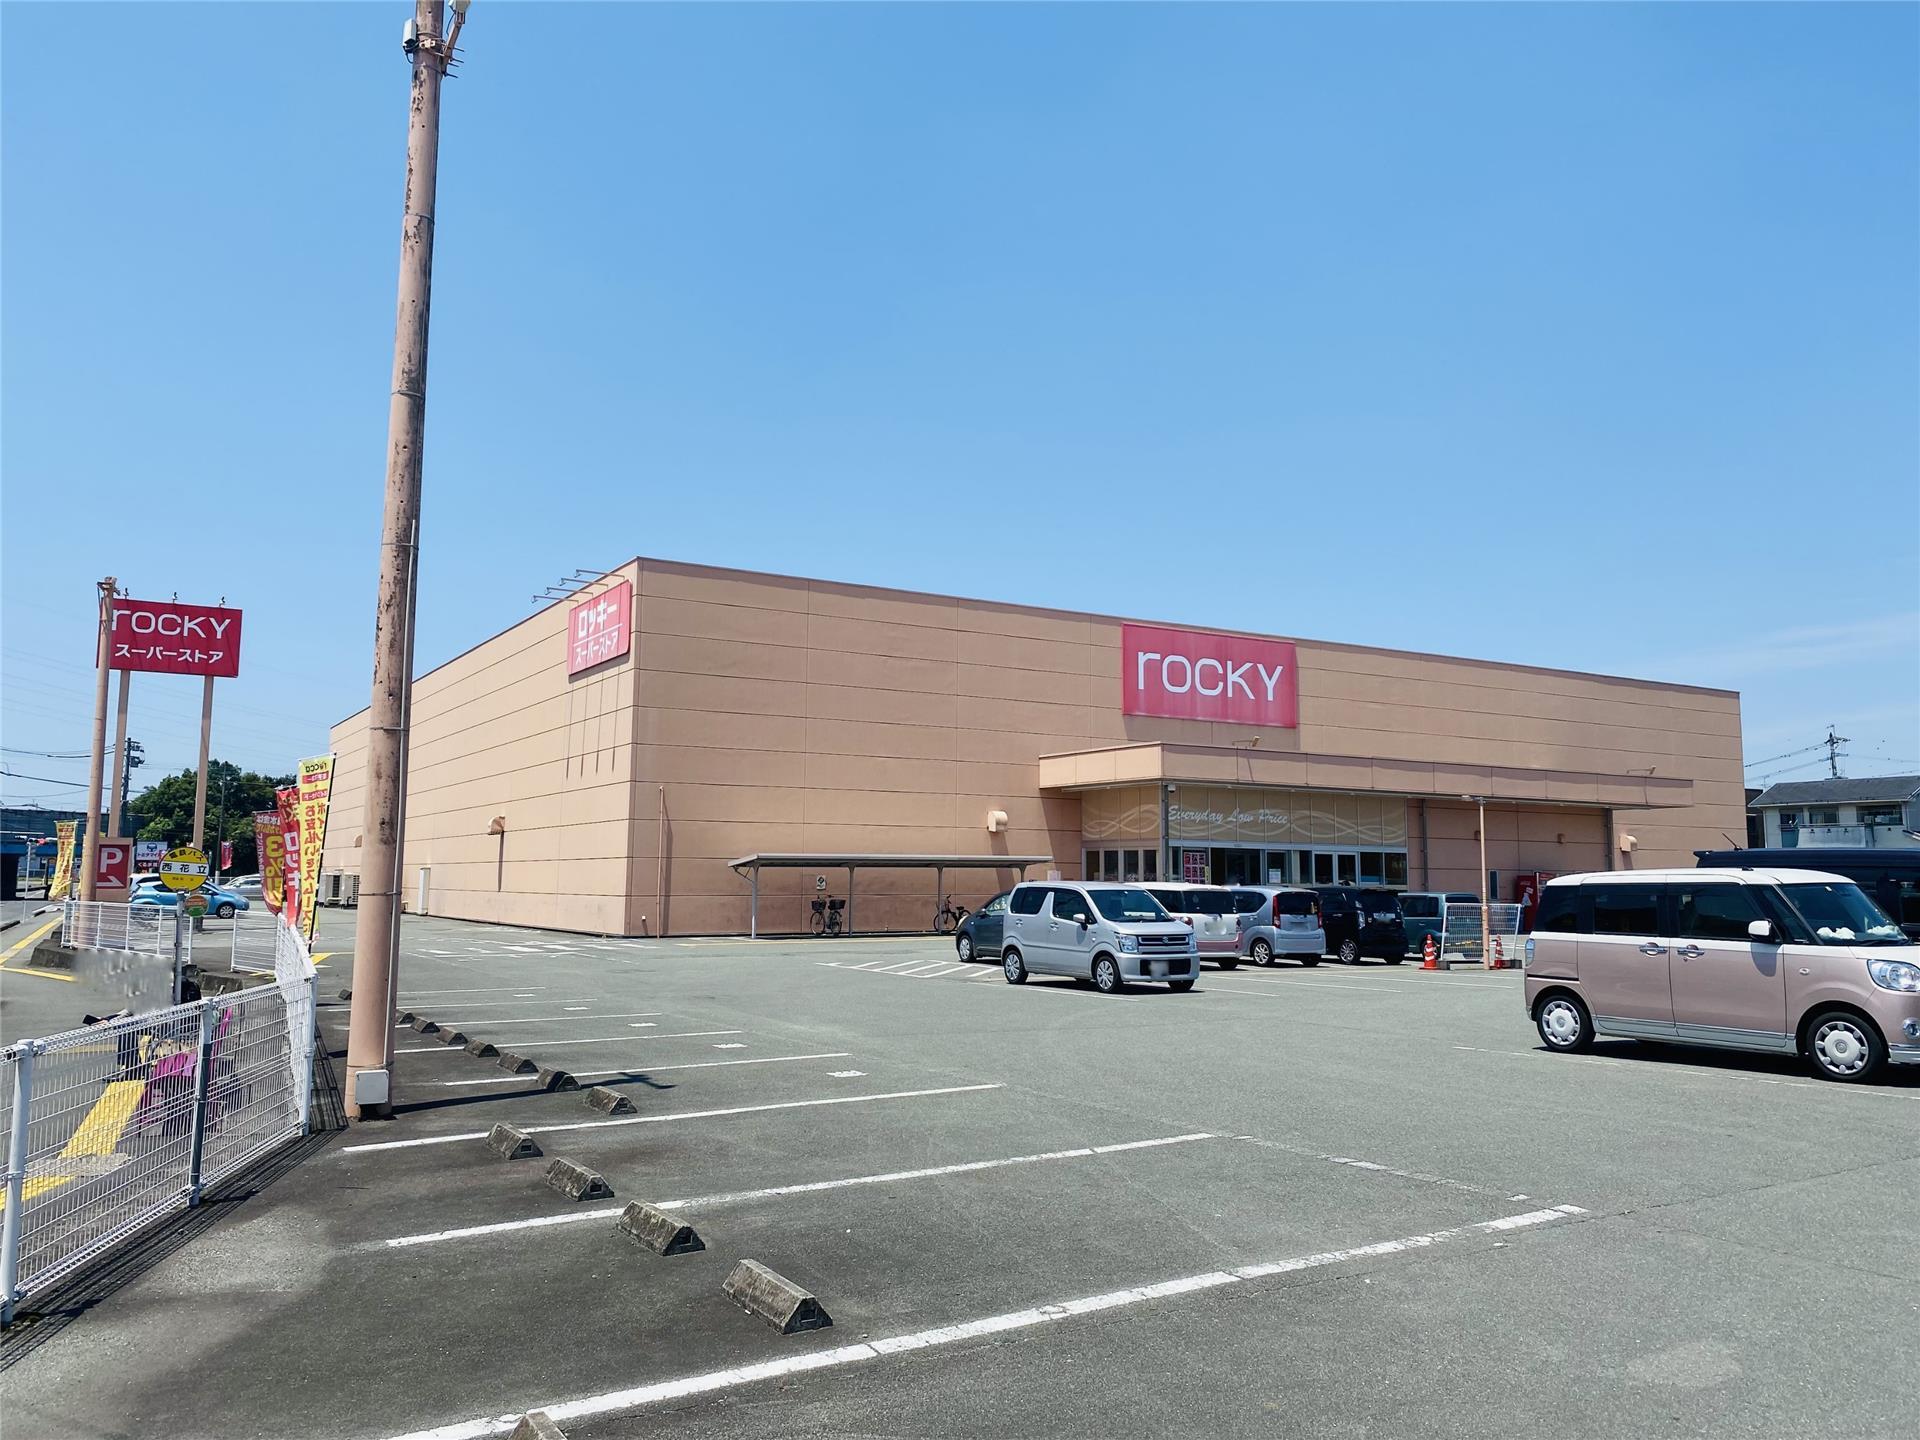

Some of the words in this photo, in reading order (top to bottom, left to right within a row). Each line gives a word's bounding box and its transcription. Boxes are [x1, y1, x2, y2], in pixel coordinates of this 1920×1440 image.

[578, 600, 617, 639] ロッキー
[115, 644, 223, 663] スーパーストア
[576, 630, 619, 665] スーパーストア
[1168, 805, 1224, 824] Everyday
[1226, 808, 1253, 822] Low
[1258, 808, 1288, 824] Price
[100, 847, 123, 873] P
